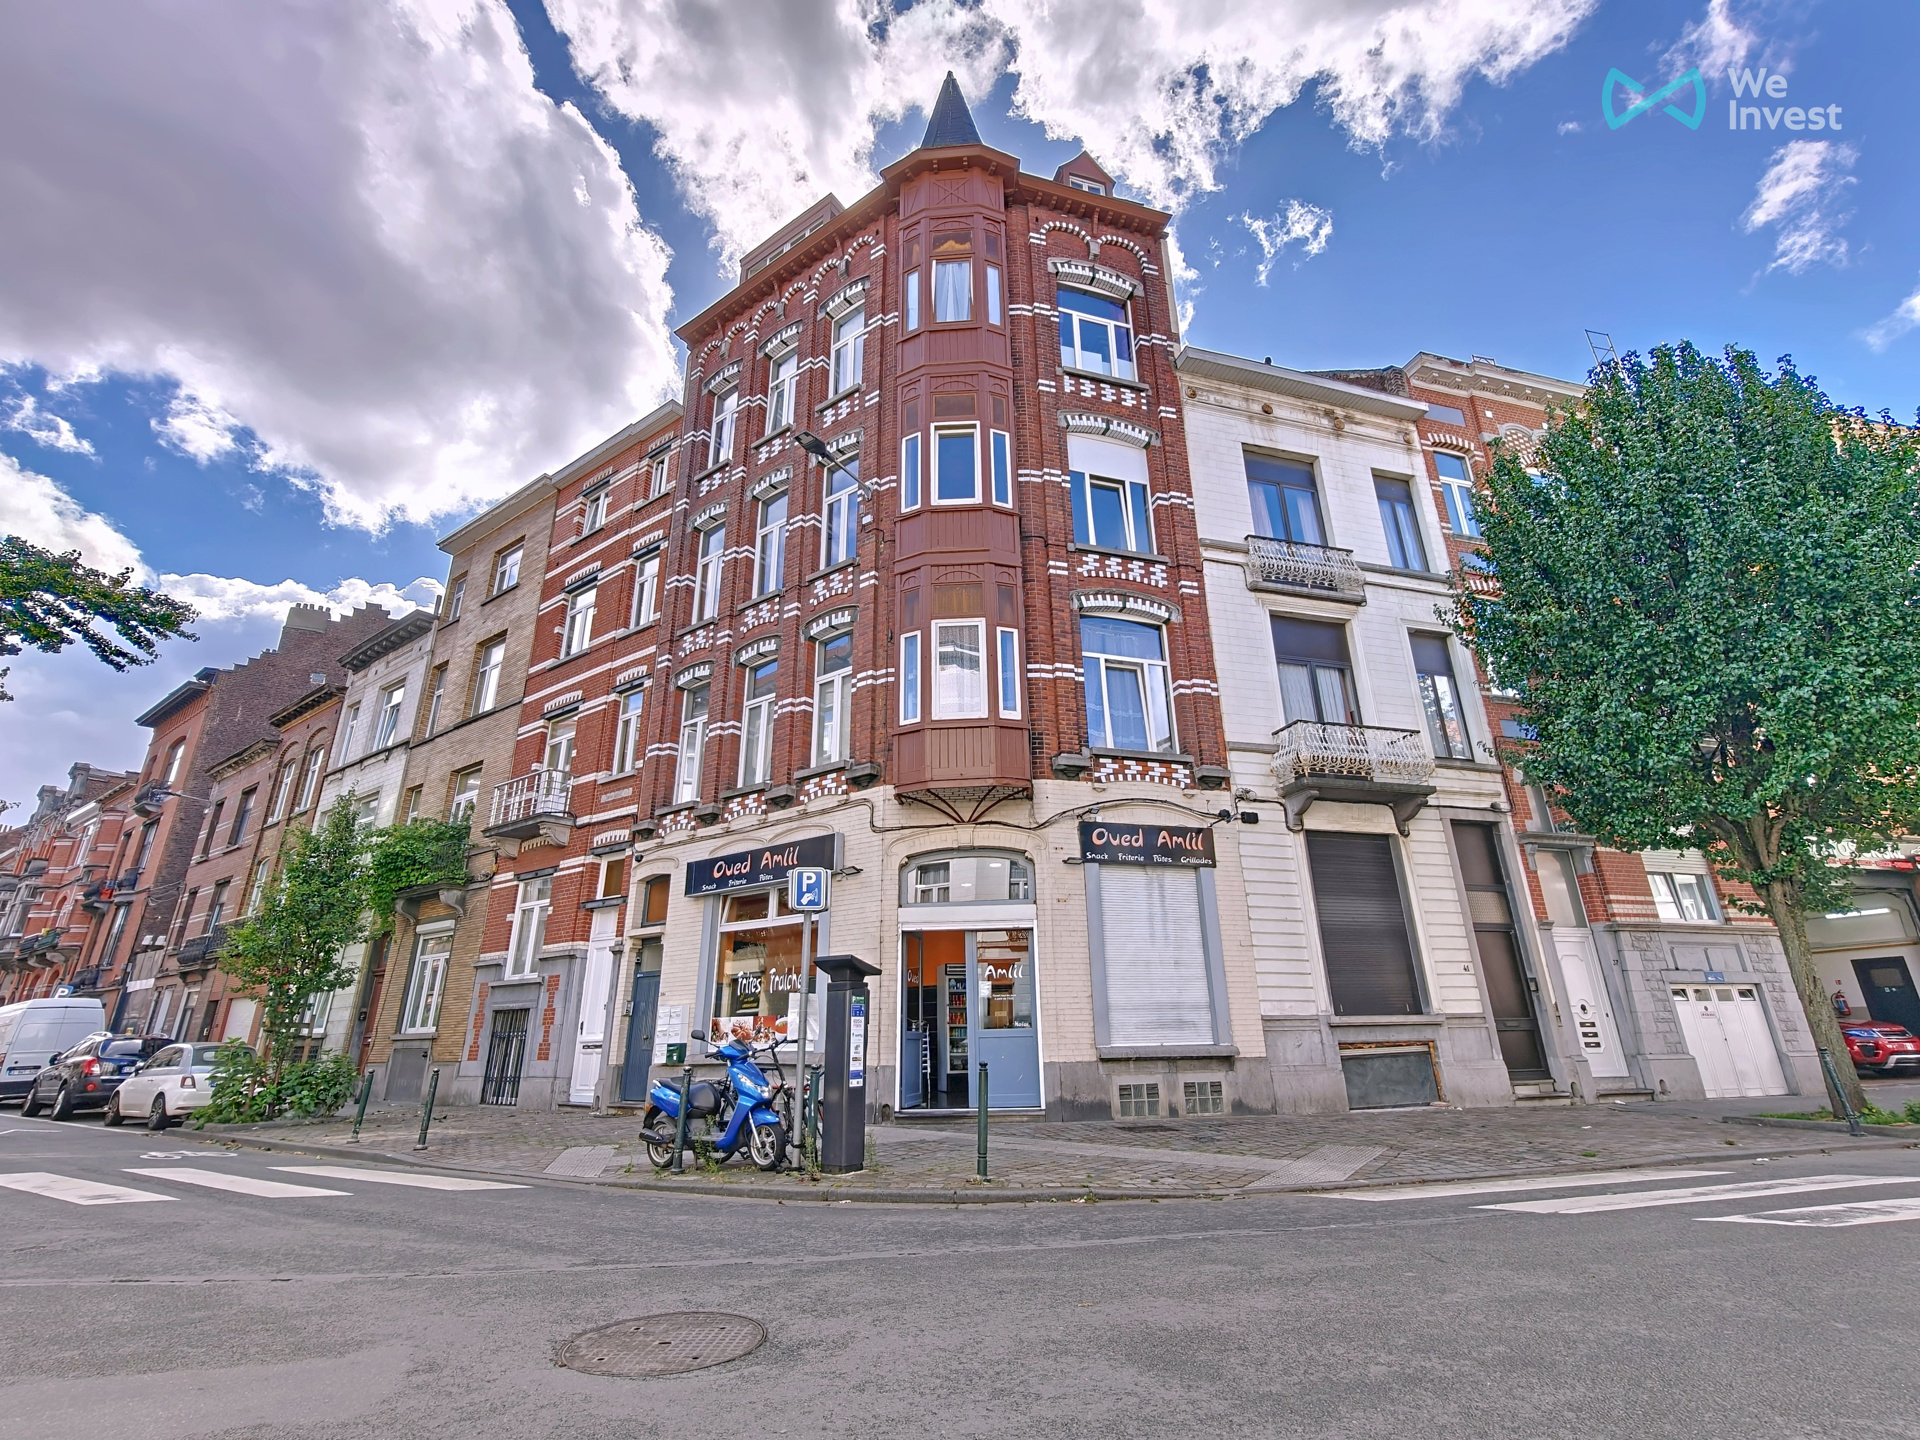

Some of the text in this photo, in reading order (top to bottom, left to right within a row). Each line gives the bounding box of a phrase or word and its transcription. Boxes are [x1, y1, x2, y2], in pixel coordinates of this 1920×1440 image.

[1091, 827, 1204, 851] Oued Amlil
[713, 845, 800, 878] Oued Amlil
[1086, 851, 1213, 865] Snack Friterie Pâtes Grillades
[702, 882, 717, 891] Snack
[728, 877, 747, 887] Friterie
[802, 872, 816, 891] P
[984, 964, 1024, 979] Amlil
[737, 970, 762, 996] Frites
